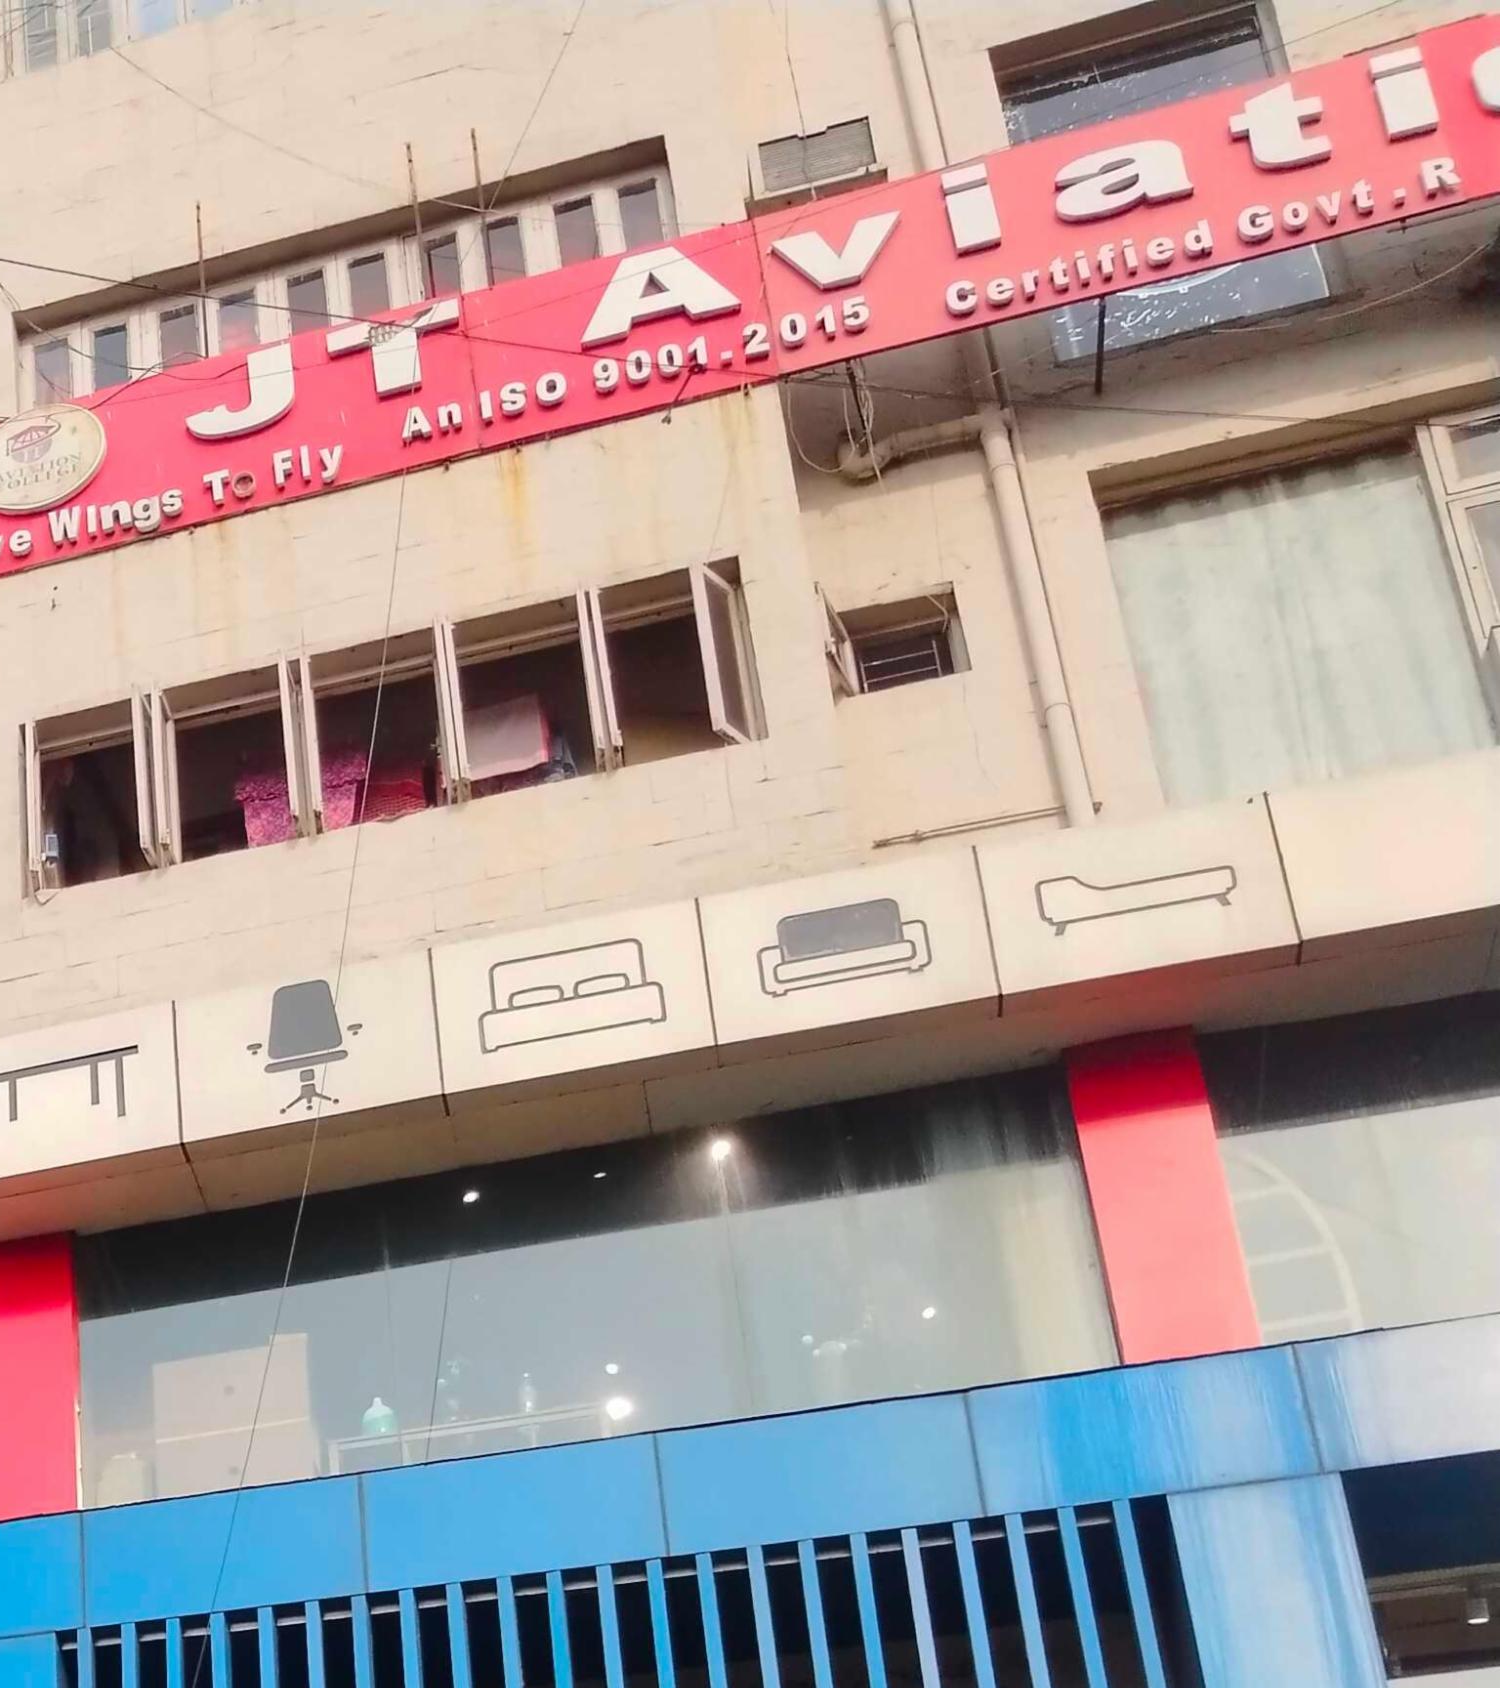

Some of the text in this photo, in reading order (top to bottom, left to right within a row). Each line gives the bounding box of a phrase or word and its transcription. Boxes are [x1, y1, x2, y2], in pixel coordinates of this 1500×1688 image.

[272, 443, 343, 491] Fly
[401, 398, 463, 444] An
[481, 370, 569, 422] ISO
[945, 219, 1214, 316] Certified
